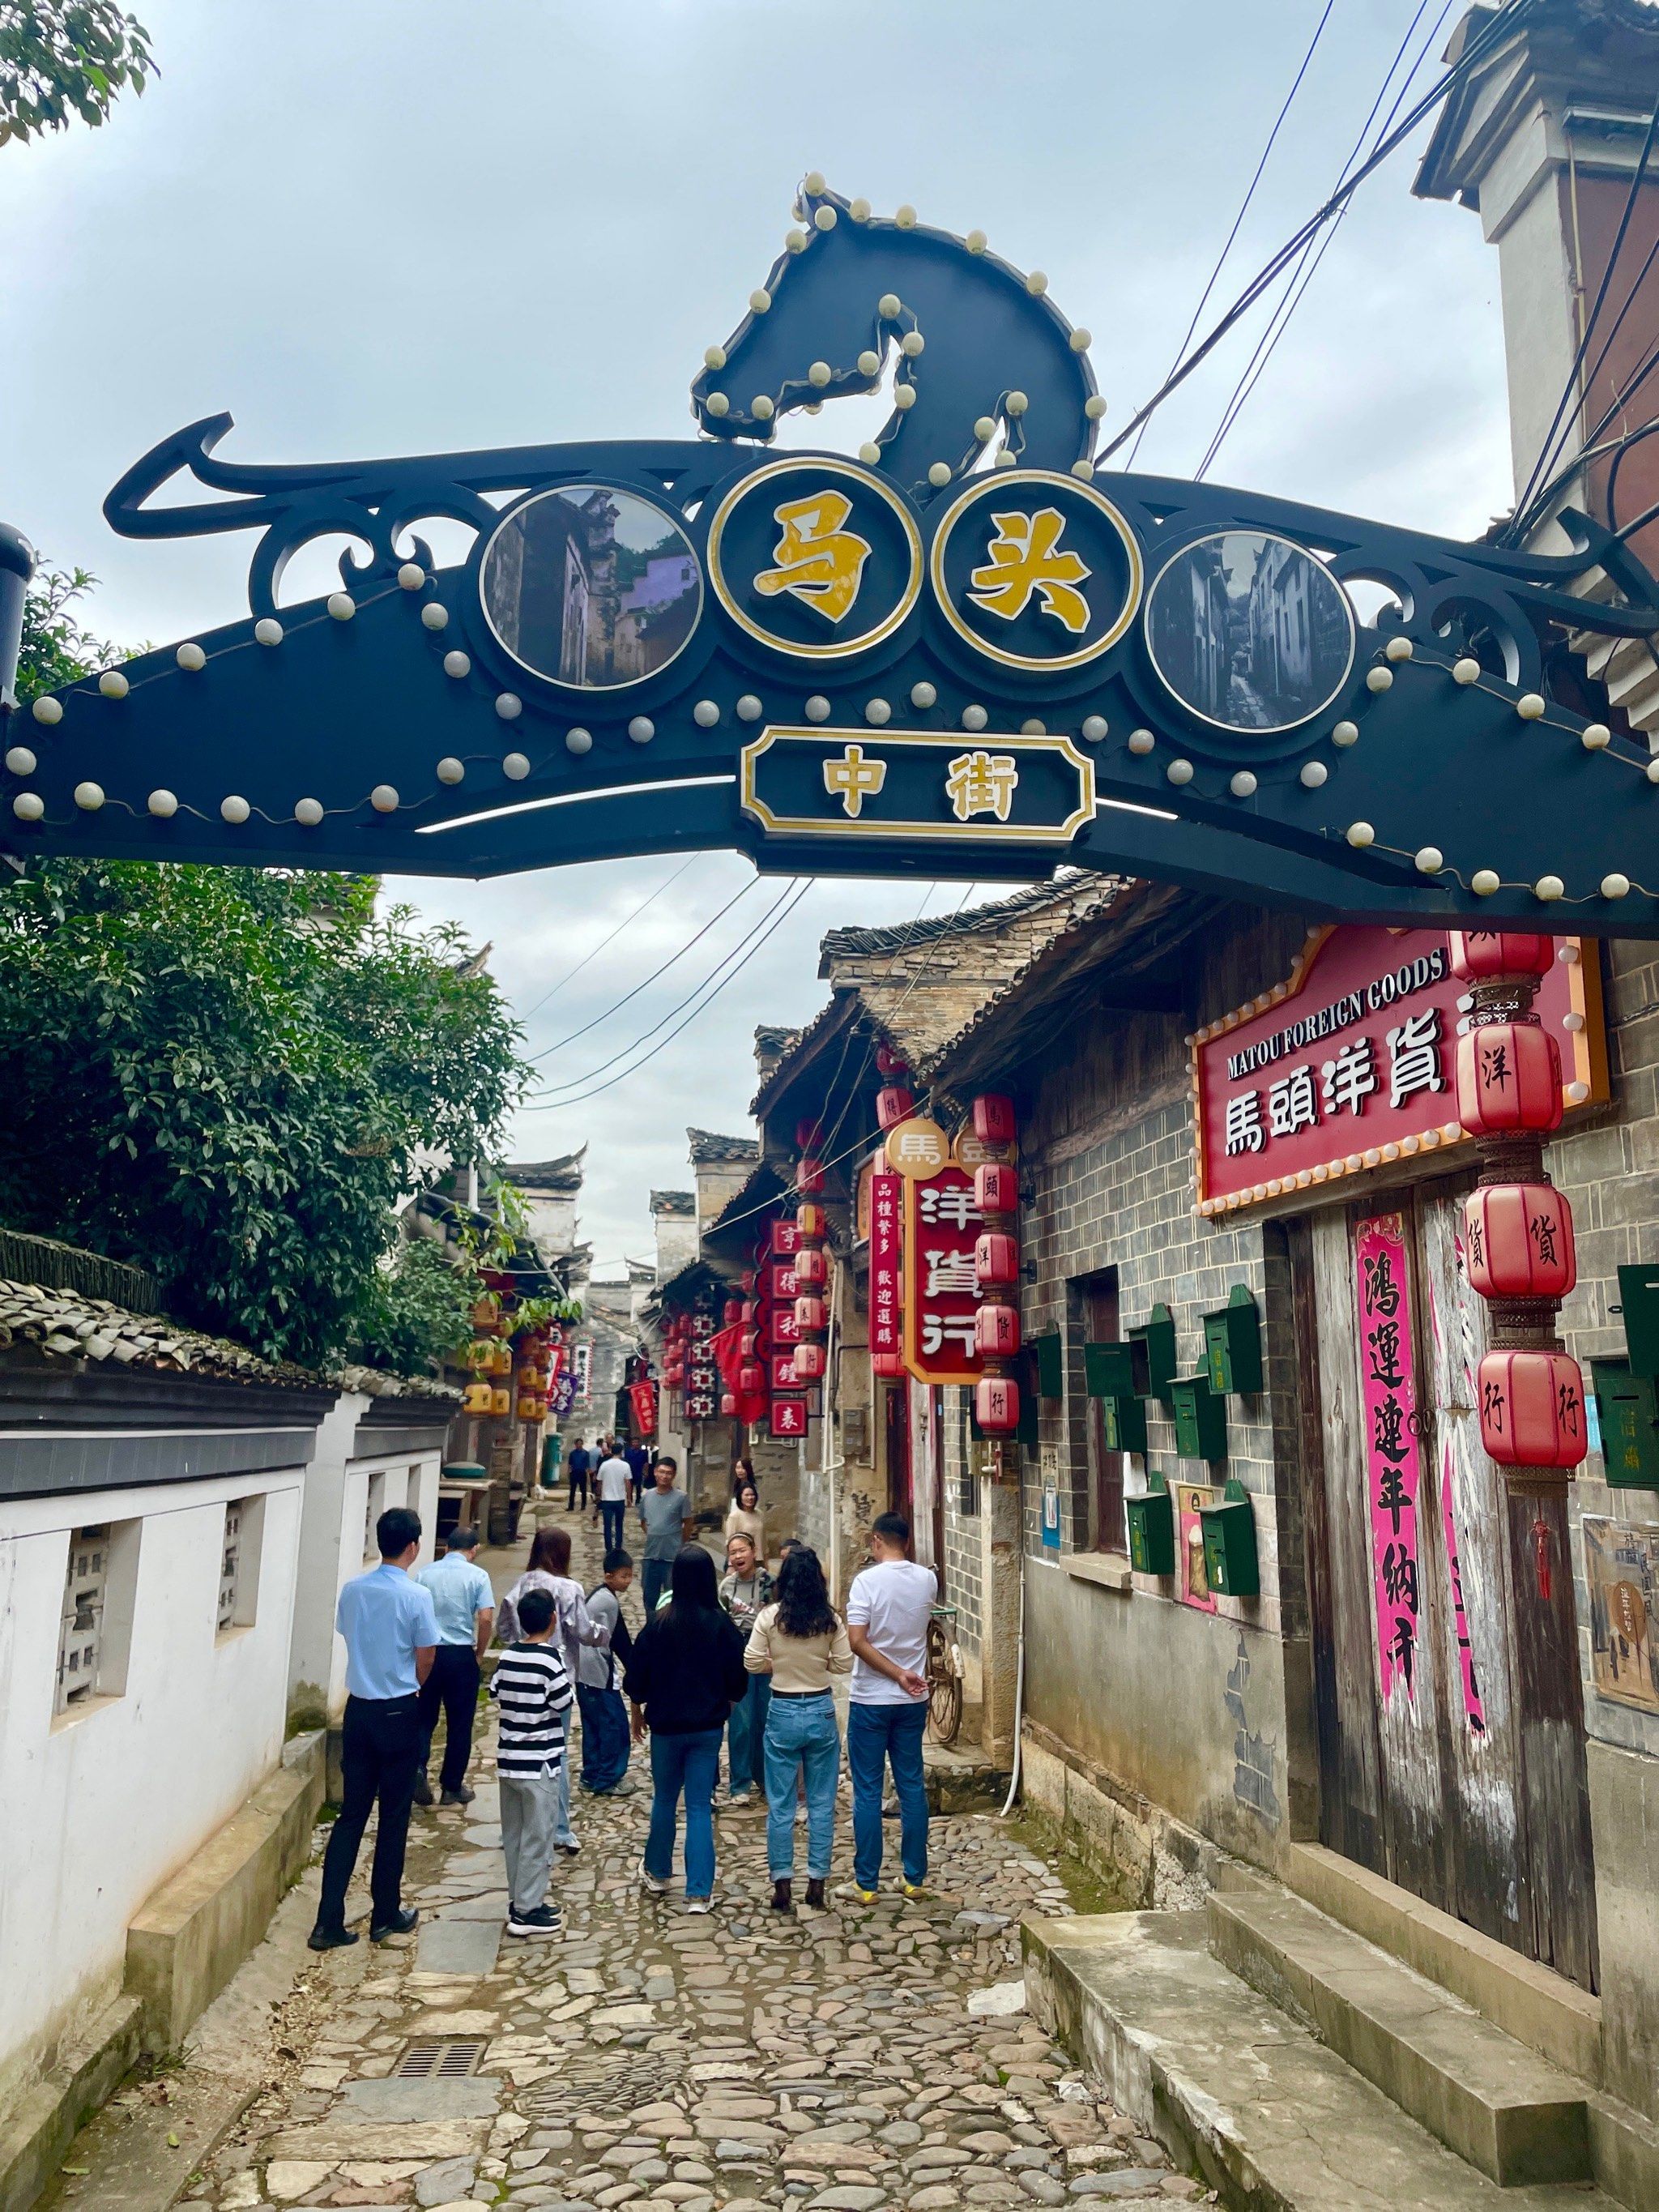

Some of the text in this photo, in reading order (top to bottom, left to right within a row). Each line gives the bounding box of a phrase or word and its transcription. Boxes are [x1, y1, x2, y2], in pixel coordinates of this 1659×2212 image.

[753, 489, 1092, 633] 马头
[822, 744, 1018, 822] 中街
[1227, 948, 1445, 1081] MATOU FOREIGN GOODS
[1225, 995, 1474, 1156] 馬頭洋貨
[1481, 1044, 1512, 1094] 洋
[876, 1183, 893, 1344] 品種繁多 歡迎選購
[1530, 1215, 1558, 1267] 貨
[1483, 1381, 1505, 1434] 行
[1559, 1382, 1580, 1438] 行
